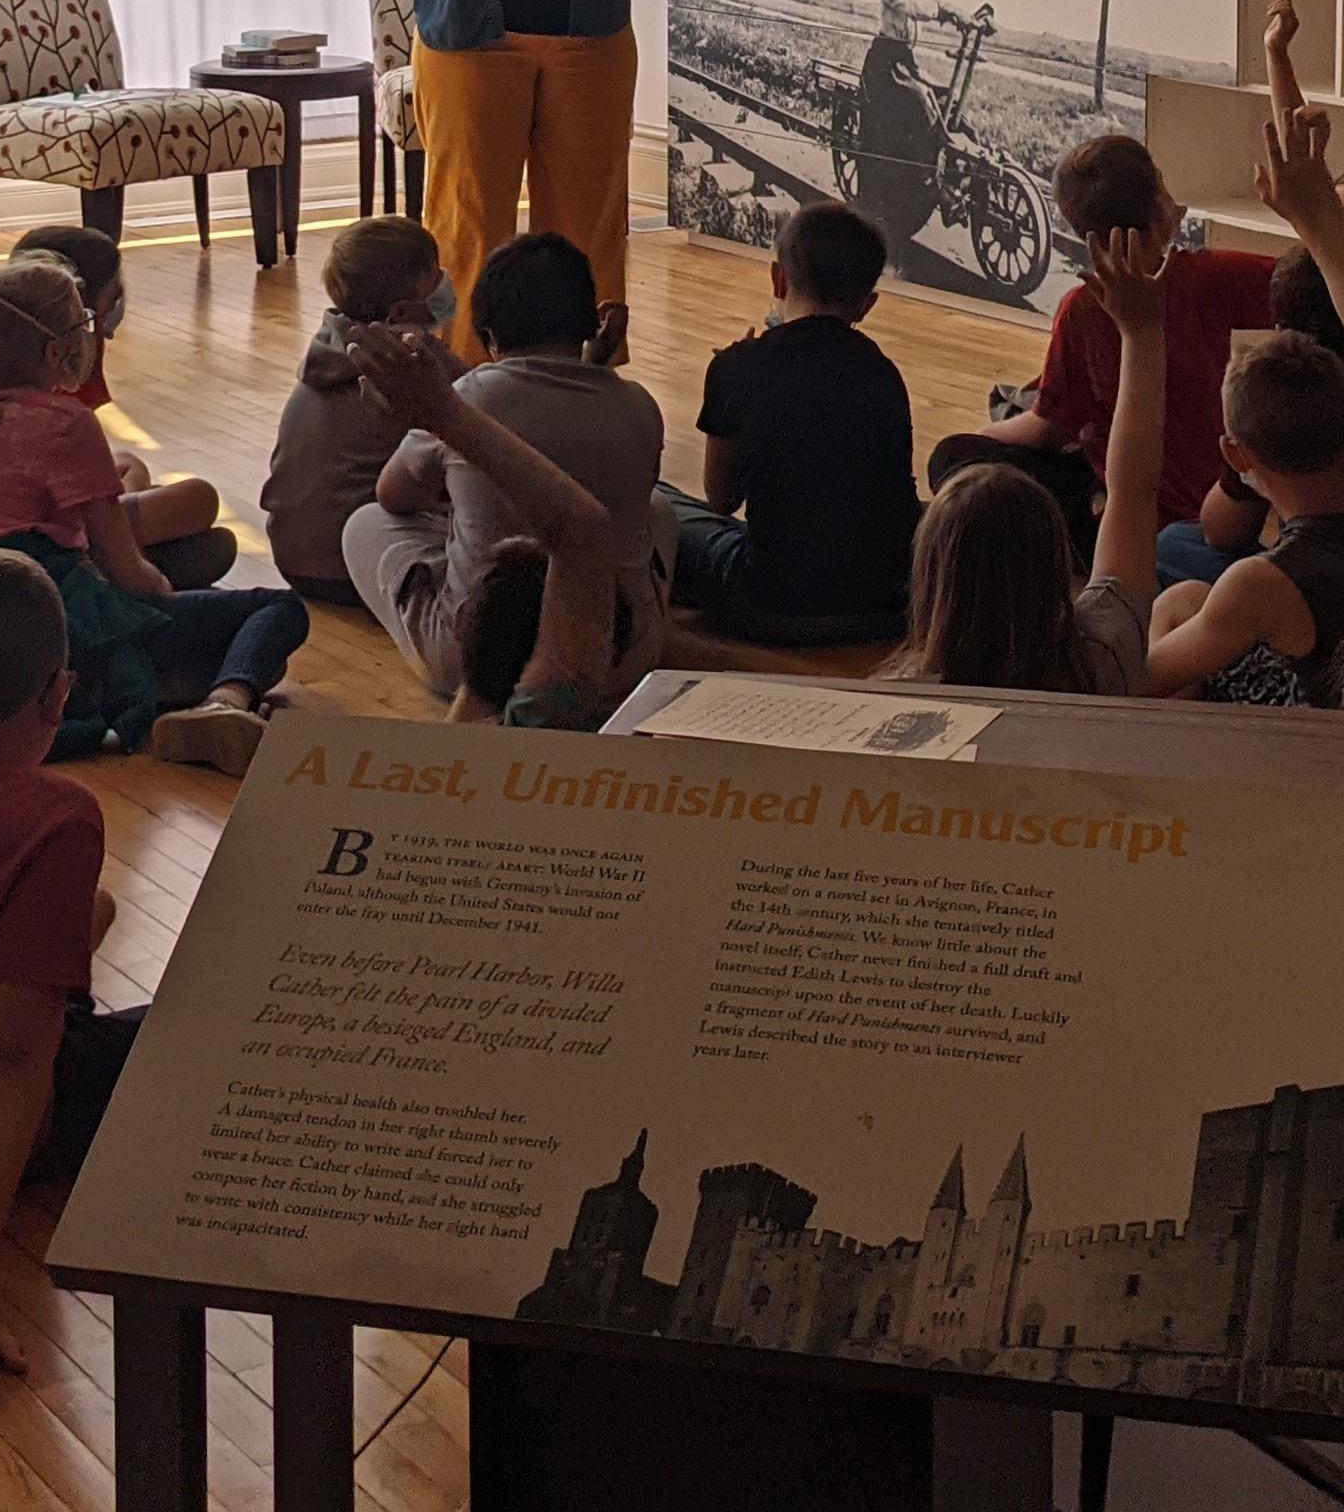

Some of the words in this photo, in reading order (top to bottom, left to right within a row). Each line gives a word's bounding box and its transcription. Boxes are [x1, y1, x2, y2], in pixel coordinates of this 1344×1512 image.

[286, 746, 327, 787] A
[349, 750, 475, 804] Last,
[504, 760, 820, 827] Unfinished
[840, 787, 1192, 864] Manuscript
[741, 859, 794, 879] During
[798, 865, 820, 878] the
[824, 867, 850, 880] last
[853, 870, 879, 883] five
[882, 876, 919, 887] years
[923, 876, 941, 888] of
[943, 877, 966, 891] her
[1002, 883, 1054, 899] Cather
[278, 943, 337, 967] Even
[340, 950, 405, 977] before
[408, 956, 472, 978] Pearl
[470, 962, 554, 990] Harbor,
[562, 970, 625, 993] Willa
[269, 974, 343, 1006] Cather
[340, 982, 381, 1005] felt
[384, 986, 419, 1004] the
[416, 992, 473, 1015] pain
[478, 995, 505, 1020] of
[503, 995, 519, 1015] a
[522, 999, 613, 1023] divided
[252, 1003, 336, 1034] Europe,
[343, 1019, 359, 1031] a
[362, 1014, 454, 1044] besieged
[452, 1023, 557, 1054] England,
[561, 1036, 612, 1056] and
[692, 1045, 730, 1058] years
[733, 1045, 769, 1060] later.
[698, 1020, 744, 1037] Lewis
[748, 1025, 818, 1044] described
[823, 1033, 847, 1046] the
[851, 1039, 889, 1054] story
[894, 1042, 909, 1052] to
[913, 1045, 931, 1055] an
[936, 1044, 1024, 1064] interviewer
[241, 1042, 272, 1056] an
[276, 1044, 370, 1068] occupied
[368, 1047, 448, 1074] France.
[218, 1102, 230, 1116] A
[236, 1104, 302, 1125] damaged
[306, 1114, 356, 1129] tendon
[361, 1119, 375, 1131] in
[379, 1119, 404, 1133] her
[408, 1124, 445, 1140] right
[449, 1127, 498, 1143] thumb
[503, 1136, 562, 1155] severely
